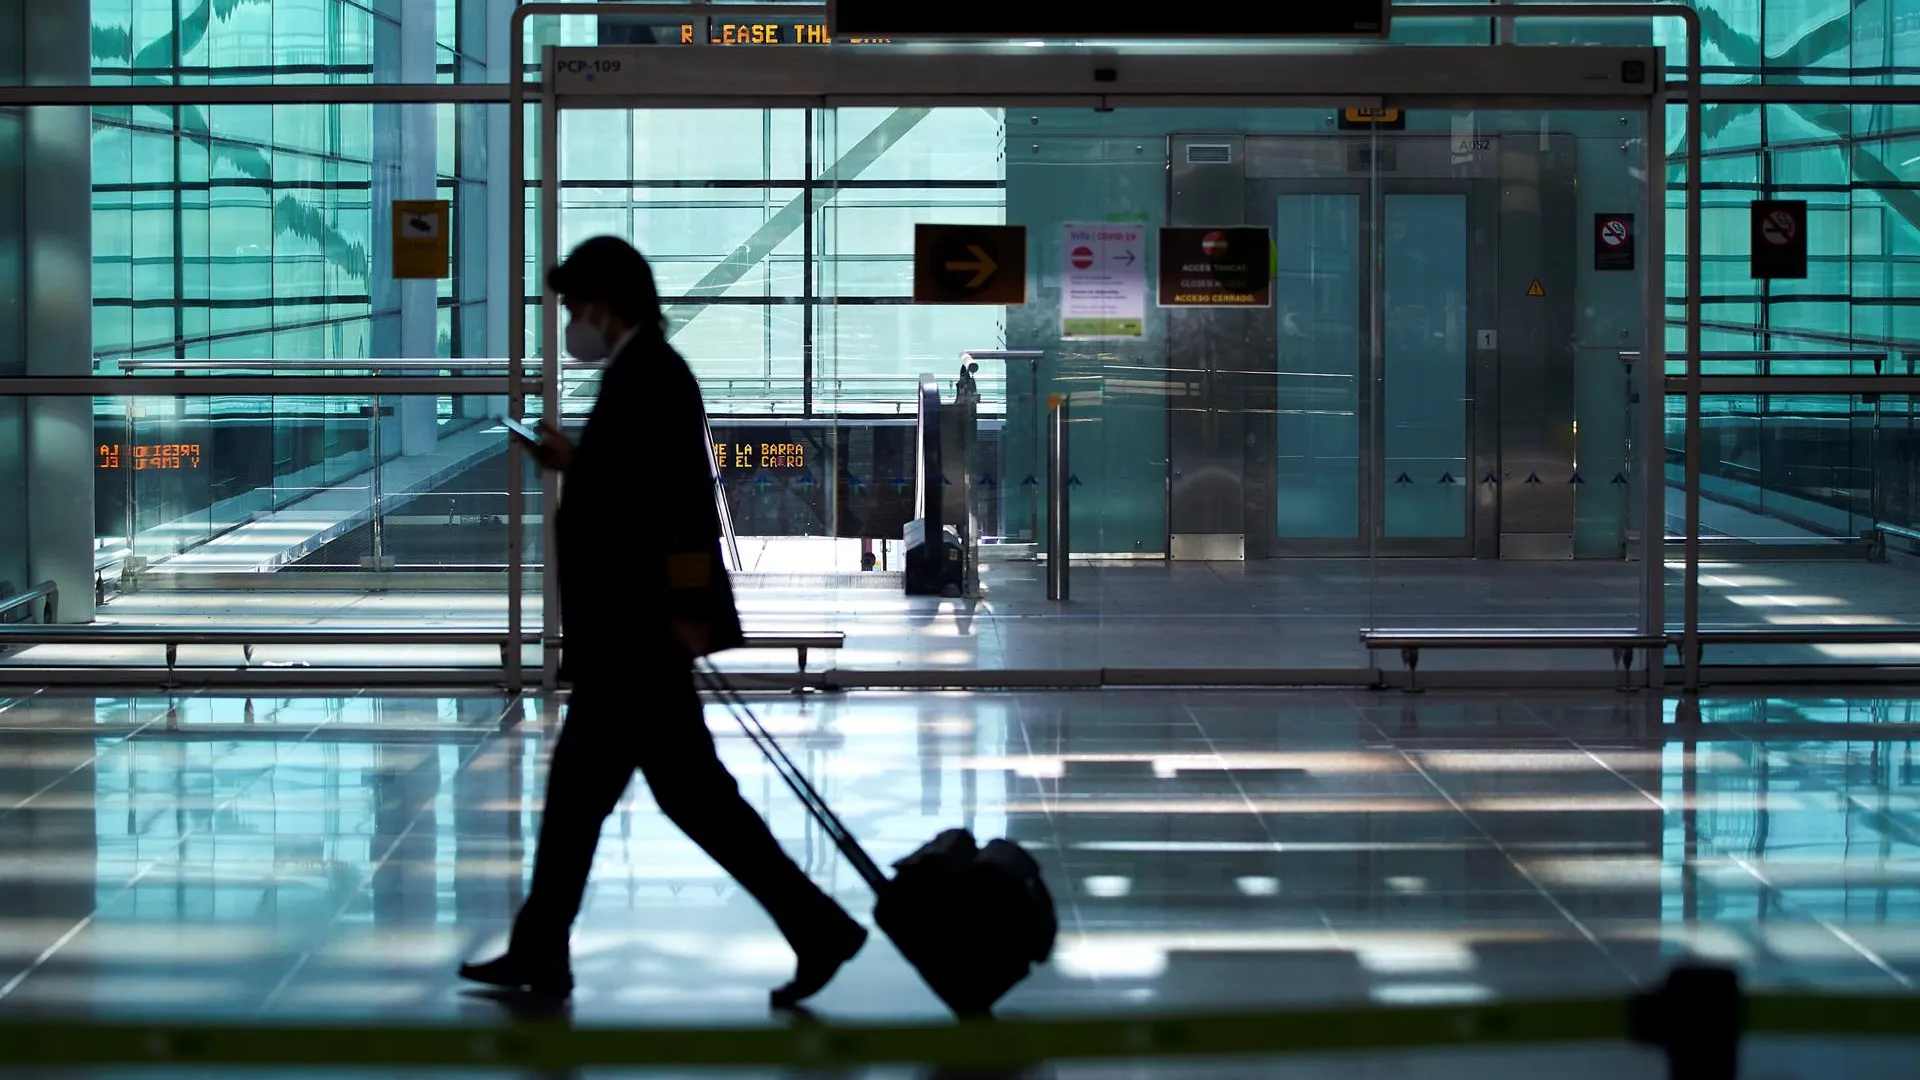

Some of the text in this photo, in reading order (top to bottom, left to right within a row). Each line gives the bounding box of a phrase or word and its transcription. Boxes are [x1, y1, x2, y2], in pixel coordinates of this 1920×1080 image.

[681, 24, 778, 43] RLEASE
[558, 60, 621, 73] PCP-109
[1174, 293, 1209, 302] ACCESO
[1484, 333, 1490, 346] 1
[736, 443, 752, 455] LA
[761, 443, 804, 455] BARRA
[736, 456, 752, 467] EL
